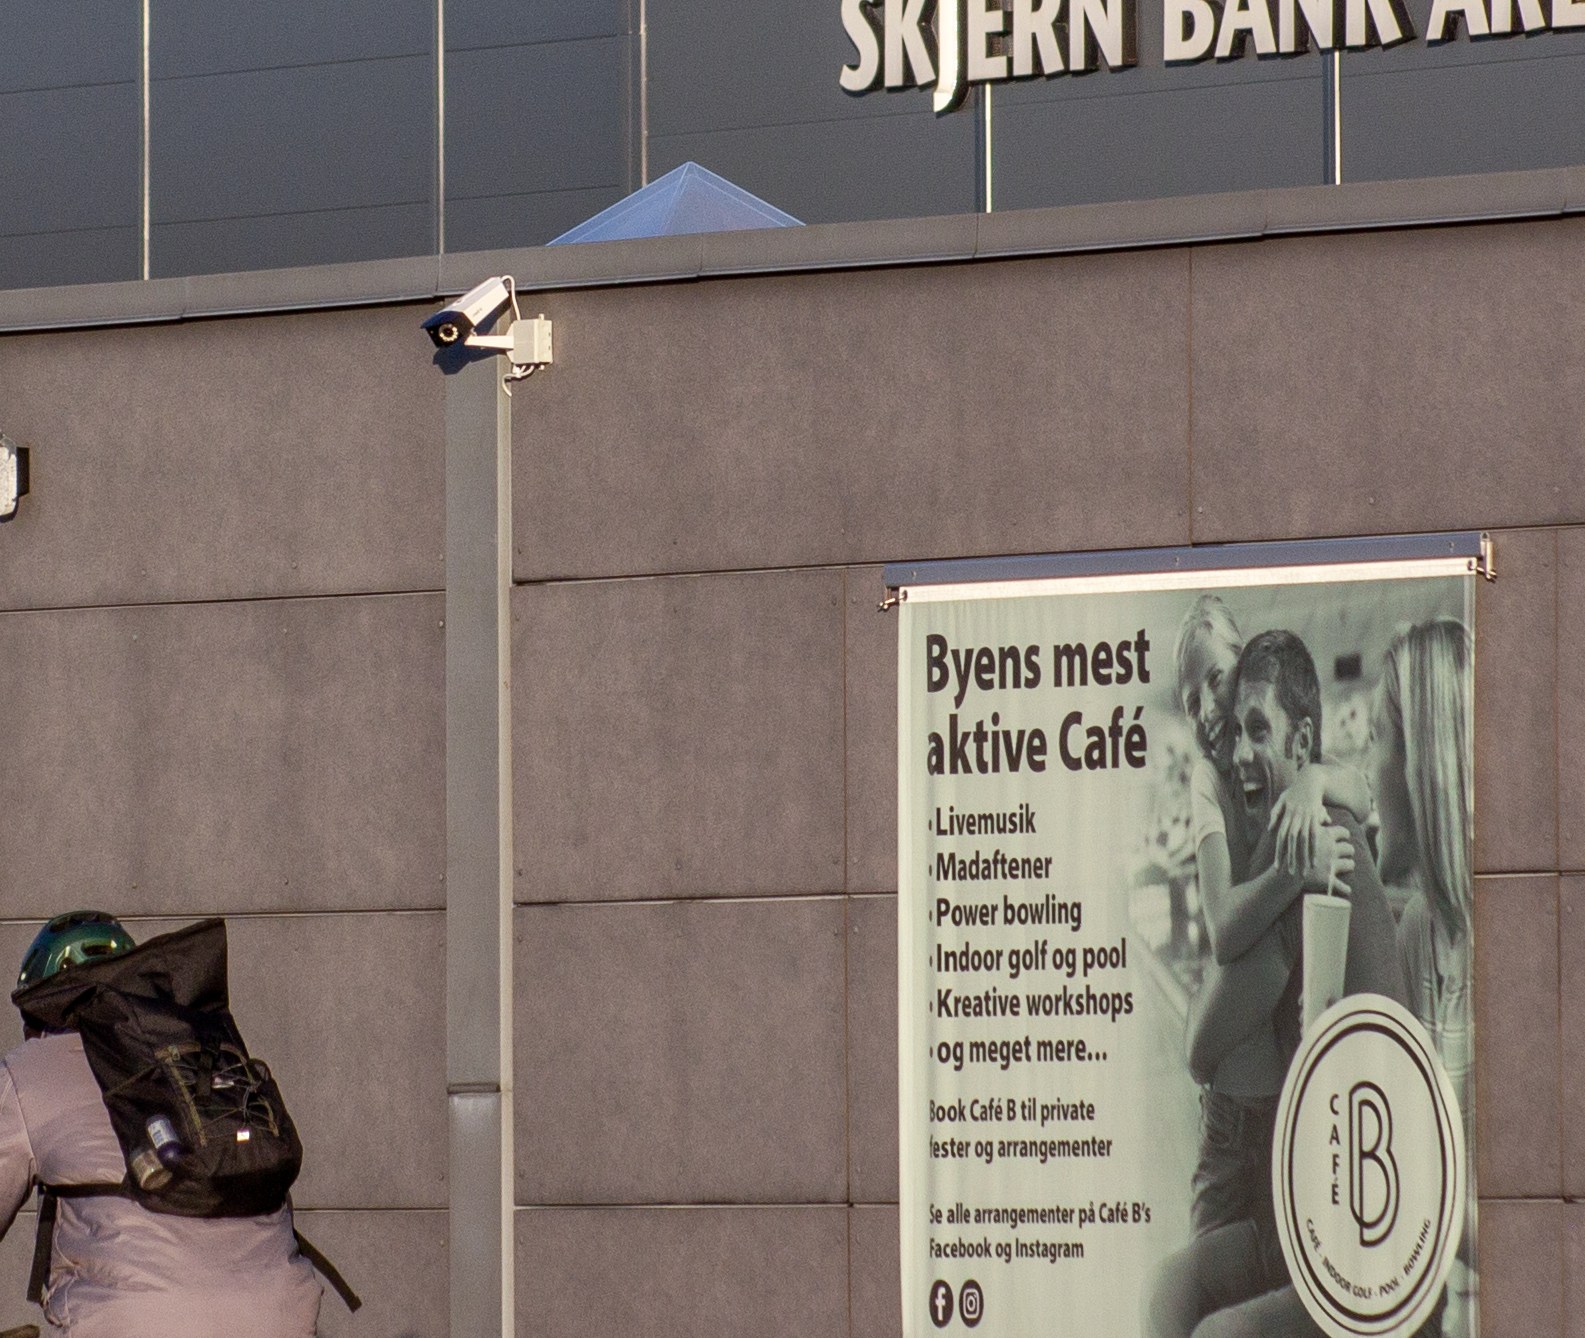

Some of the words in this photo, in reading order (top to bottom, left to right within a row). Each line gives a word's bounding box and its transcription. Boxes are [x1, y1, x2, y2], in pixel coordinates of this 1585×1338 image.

[926, 633, 1041, 709] Byens
[1053, 629, 1150, 688] mest
[927, 711, 1047, 775] aktive
[1059, 706, 1147, 771] Café
[936, 804, 1036, 836] Livemusik
[936, 849, 1052, 882] Madaftener
[936, 898, 998, 927] Power
[1003, 894, 1081, 931] bowling
[936, 942, 1002, 972] Indoor
[1008, 940, 1047, 979] golf
[1052, 949, 1076, 977] og
[1083, 938, 1126, 977] pool
[936, 987, 1020, 1018] Kreative
[1026, 985, 1133, 1022] workshops
[937, 1040, 964, 1070] og
[969, 1038, 1031, 1070] meget
[1036, 1036, 1107, 1063] mere...
[929, 1098, 966, 1123] Book
[970, 1098, 1002, 1122] Café
[1007, 1099, 1016, 1121] B
[1020, 1098, 1036, 1121] til
[1041, 1097, 1095, 1127] private
[974, 1140, 993, 1164] og
[998, 1136, 1112, 1164] arrangementer
[1349, 1080, 1400, 1248] B
[929, 1203, 942, 1224] Se
[947, 1203, 970, 1223] alle
[974, 1205, 1075, 1229] arrangementer
[1079, 1201, 1095, 1228] på
[1099, 1202, 1128, 1223] Café
[929, 1237, 992, 1259] Facebook
[995, 1241, 1012, 1263] og
[1015, 1238, 1084, 1263] Instagram
